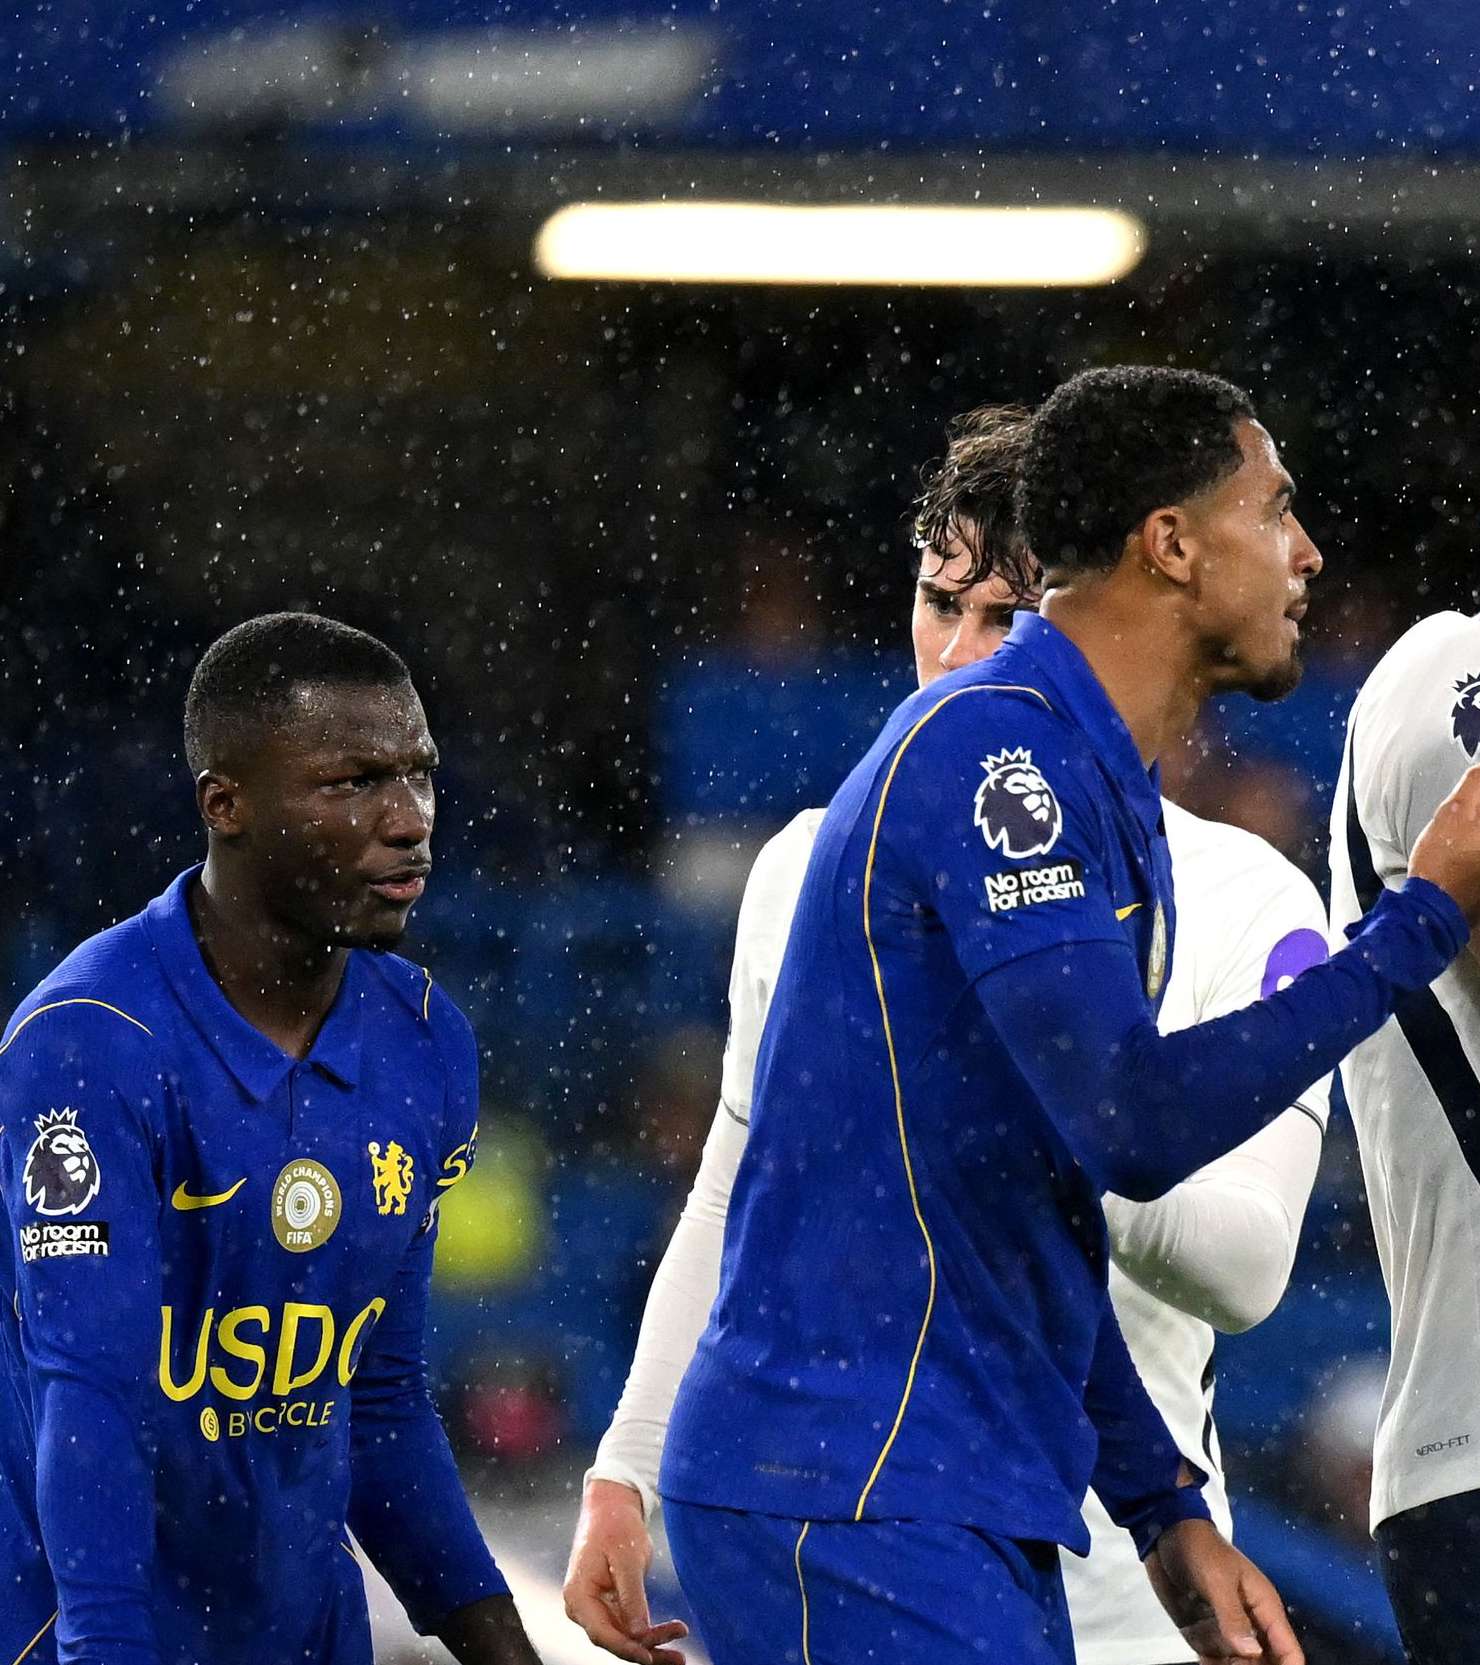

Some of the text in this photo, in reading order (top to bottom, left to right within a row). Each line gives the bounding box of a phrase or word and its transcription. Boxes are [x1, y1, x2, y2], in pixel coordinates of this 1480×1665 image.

[984, 865, 1073, 893] No room
[1022, 881, 1085, 905] racism
[276, 1166, 334, 1217] WORLD CHAMPIONS
[20, 1225, 99, 1245] No room
[286, 1231, 312, 1244] FIFA
[41, 1241, 108, 1257] racism
[254, 1401, 335, 1433] CCLE
